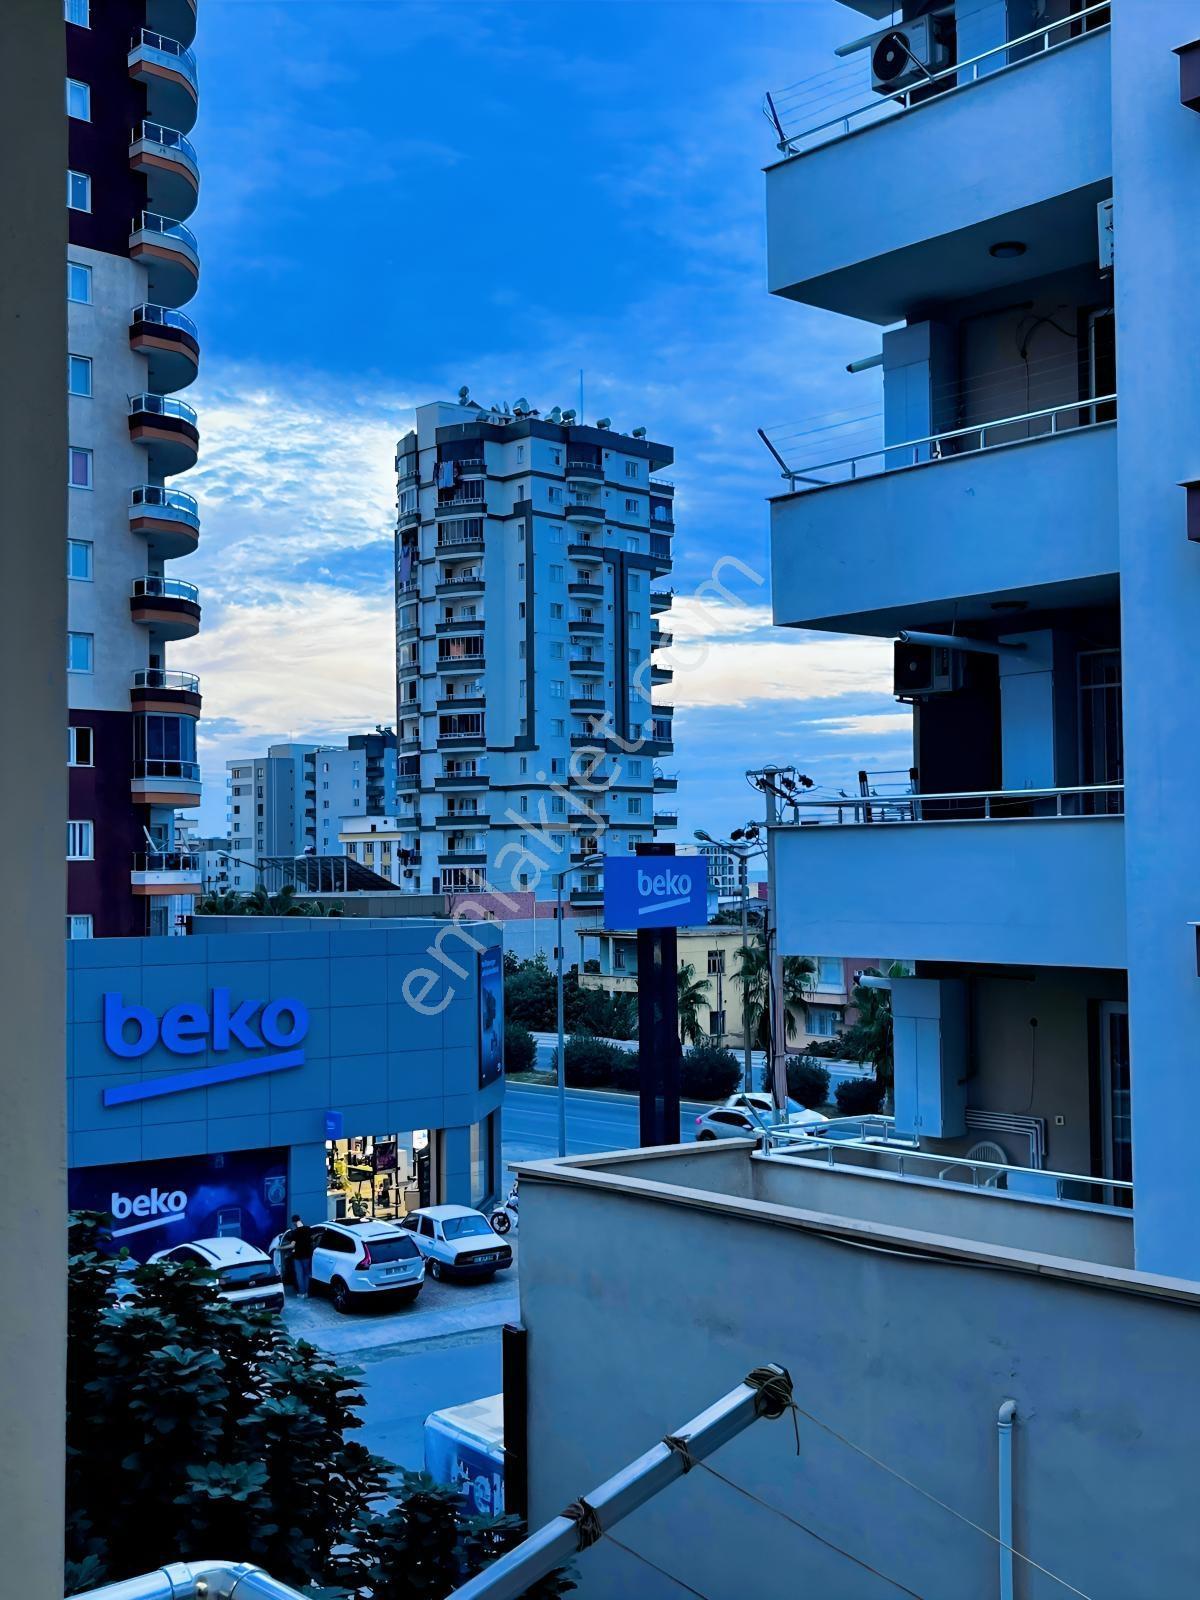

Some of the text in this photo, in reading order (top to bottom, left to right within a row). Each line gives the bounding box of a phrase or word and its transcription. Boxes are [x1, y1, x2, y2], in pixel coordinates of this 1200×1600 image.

[637, 868, 693, 897] beko
[104, 987, 309, 1058] beko
[111, 1187, 187, 1219] beko
